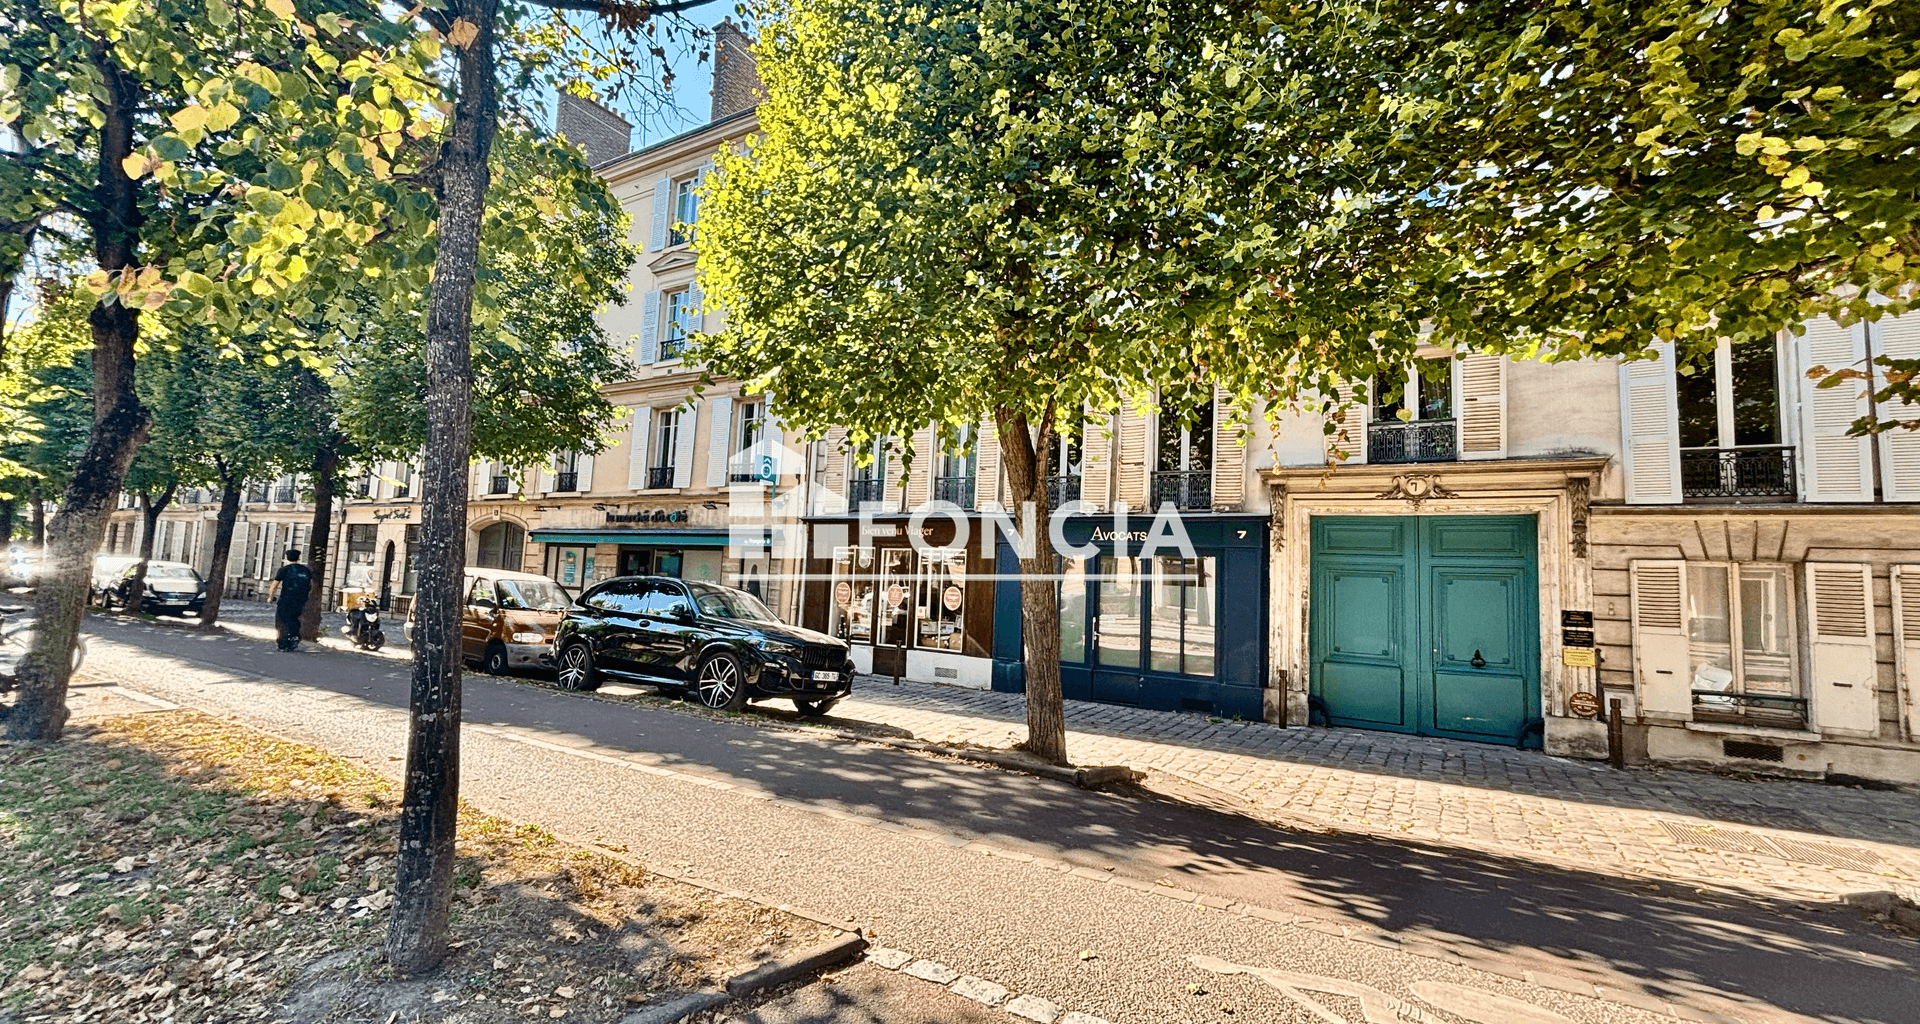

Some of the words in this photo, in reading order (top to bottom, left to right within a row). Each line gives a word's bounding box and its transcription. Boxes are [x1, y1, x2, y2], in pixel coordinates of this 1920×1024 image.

[861, 525, 881, 536] bien
[882, 527, 903, 536] venu
[905, 525, 934, 539] Viager
[1236, 530, 1247, 539] 7
